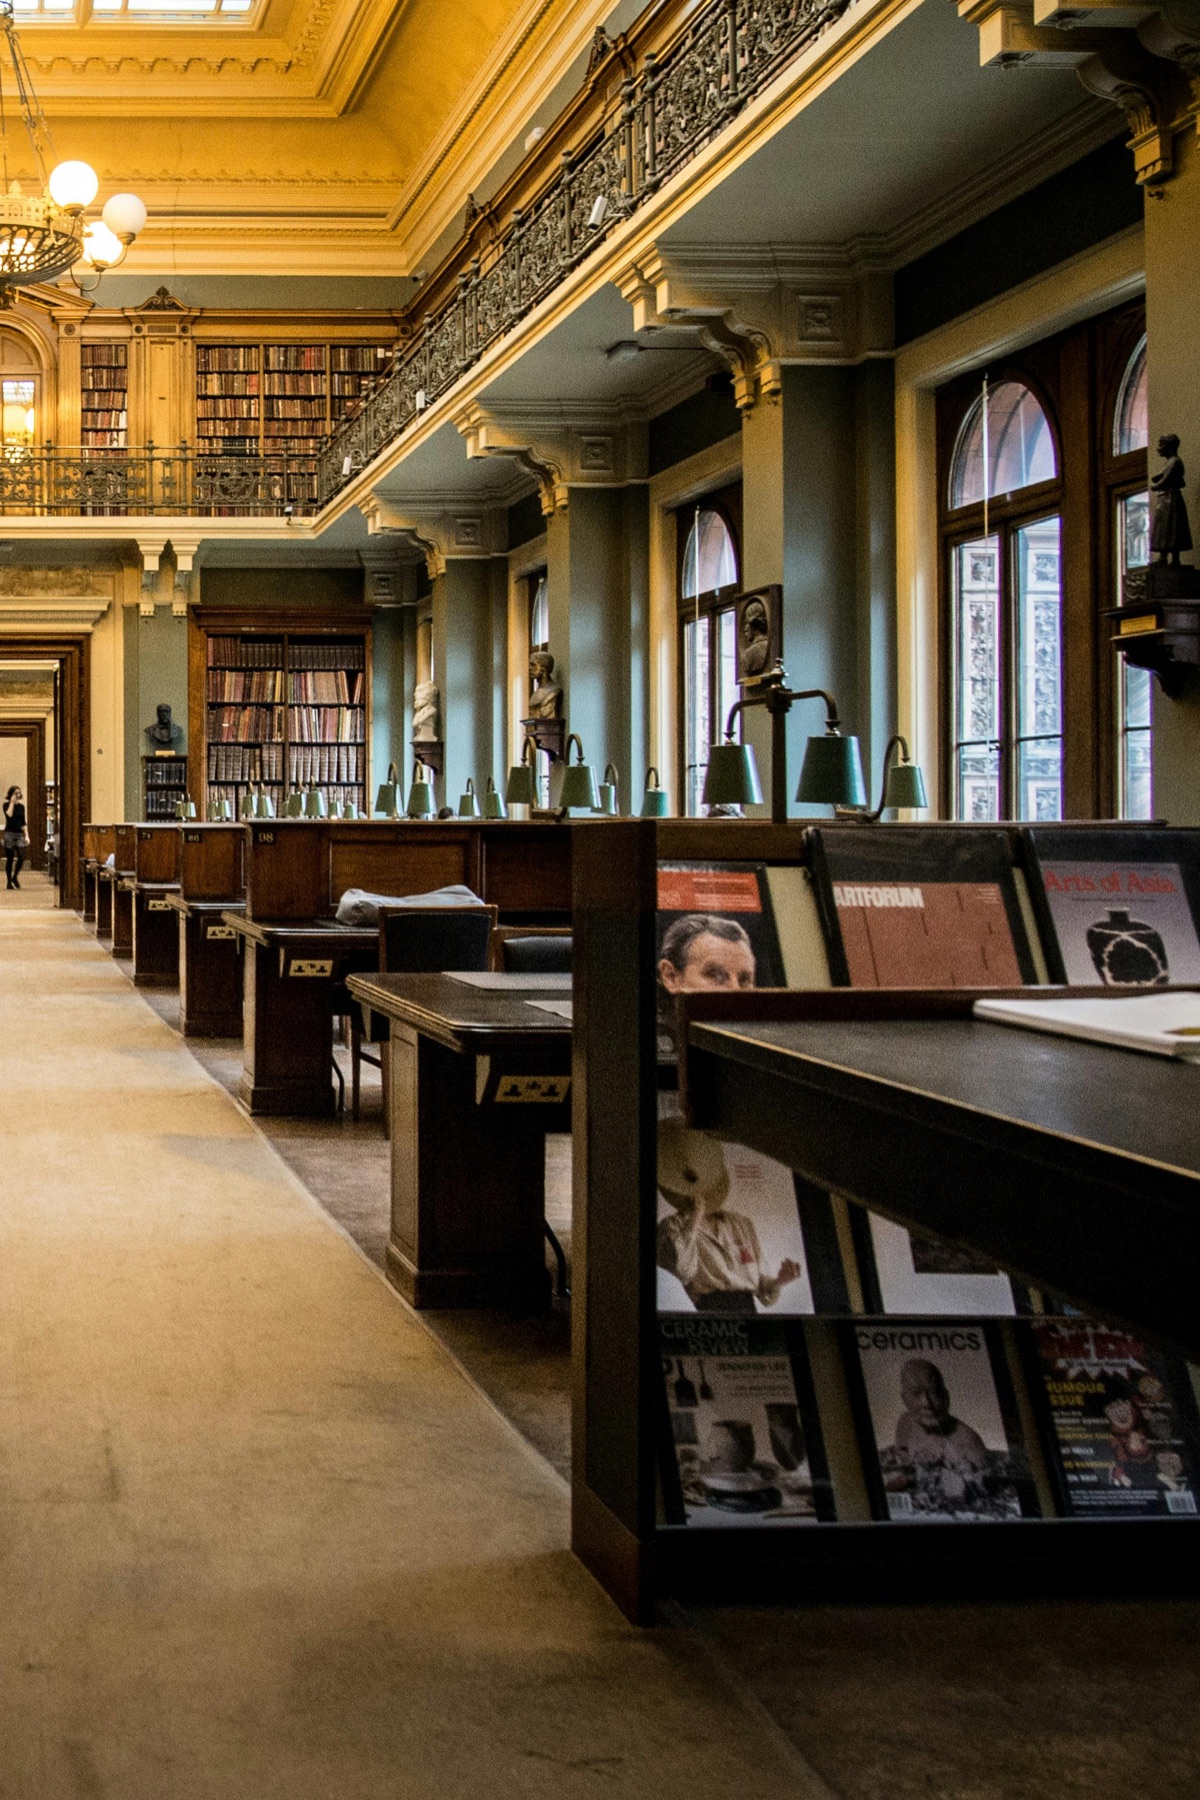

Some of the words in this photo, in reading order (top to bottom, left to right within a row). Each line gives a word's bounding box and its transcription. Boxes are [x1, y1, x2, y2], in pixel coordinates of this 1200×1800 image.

[1043, 869, 1097, 892] Arts
[1099, 872, 1121, 892] of
[1127, 872, 1178, 893] Asia
[832, 886, 925, 908] ARTFORUM
[660, 1320, 750, 1339] CERAMIC
[688, 1337, 750, 1354] REVIEW
[857, 1331, 981, 1351] ceramics
